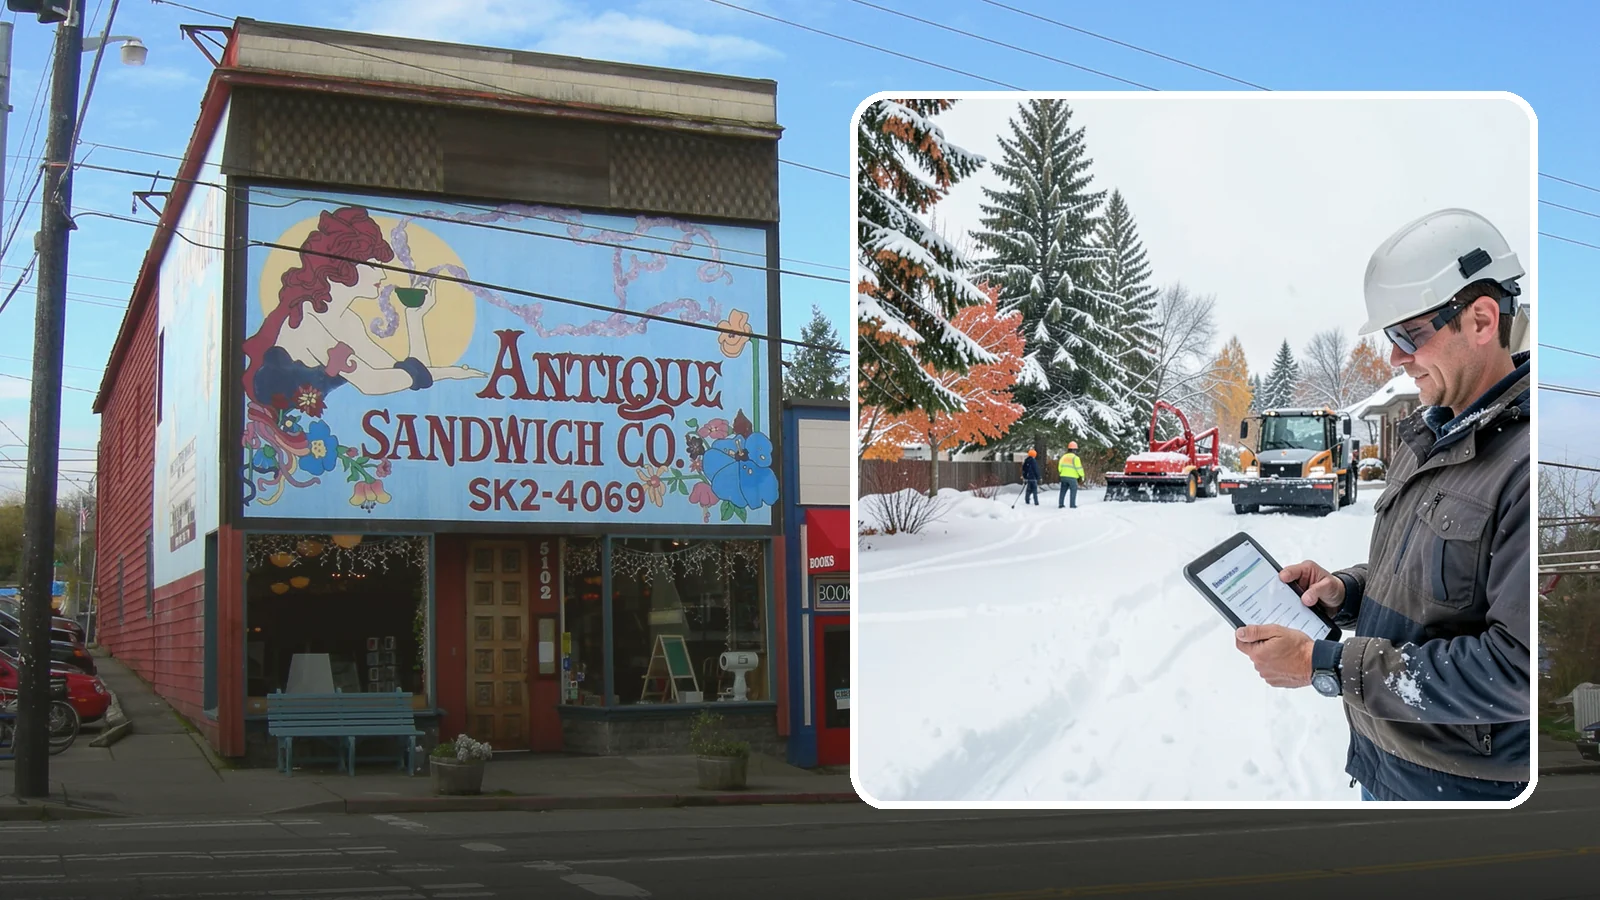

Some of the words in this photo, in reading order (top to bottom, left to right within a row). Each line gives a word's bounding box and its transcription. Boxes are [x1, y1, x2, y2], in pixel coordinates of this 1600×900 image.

[475, 328, 723, 420] ANTIQUE
[361, 408, 604, 467] SANDWICH
[617, 421, 684, 468] CO.
[468, 477, 645, 513] SK2-4069
[540, 541, 552, 600] 5102
[809, 555, 835, 569] BOOKS
